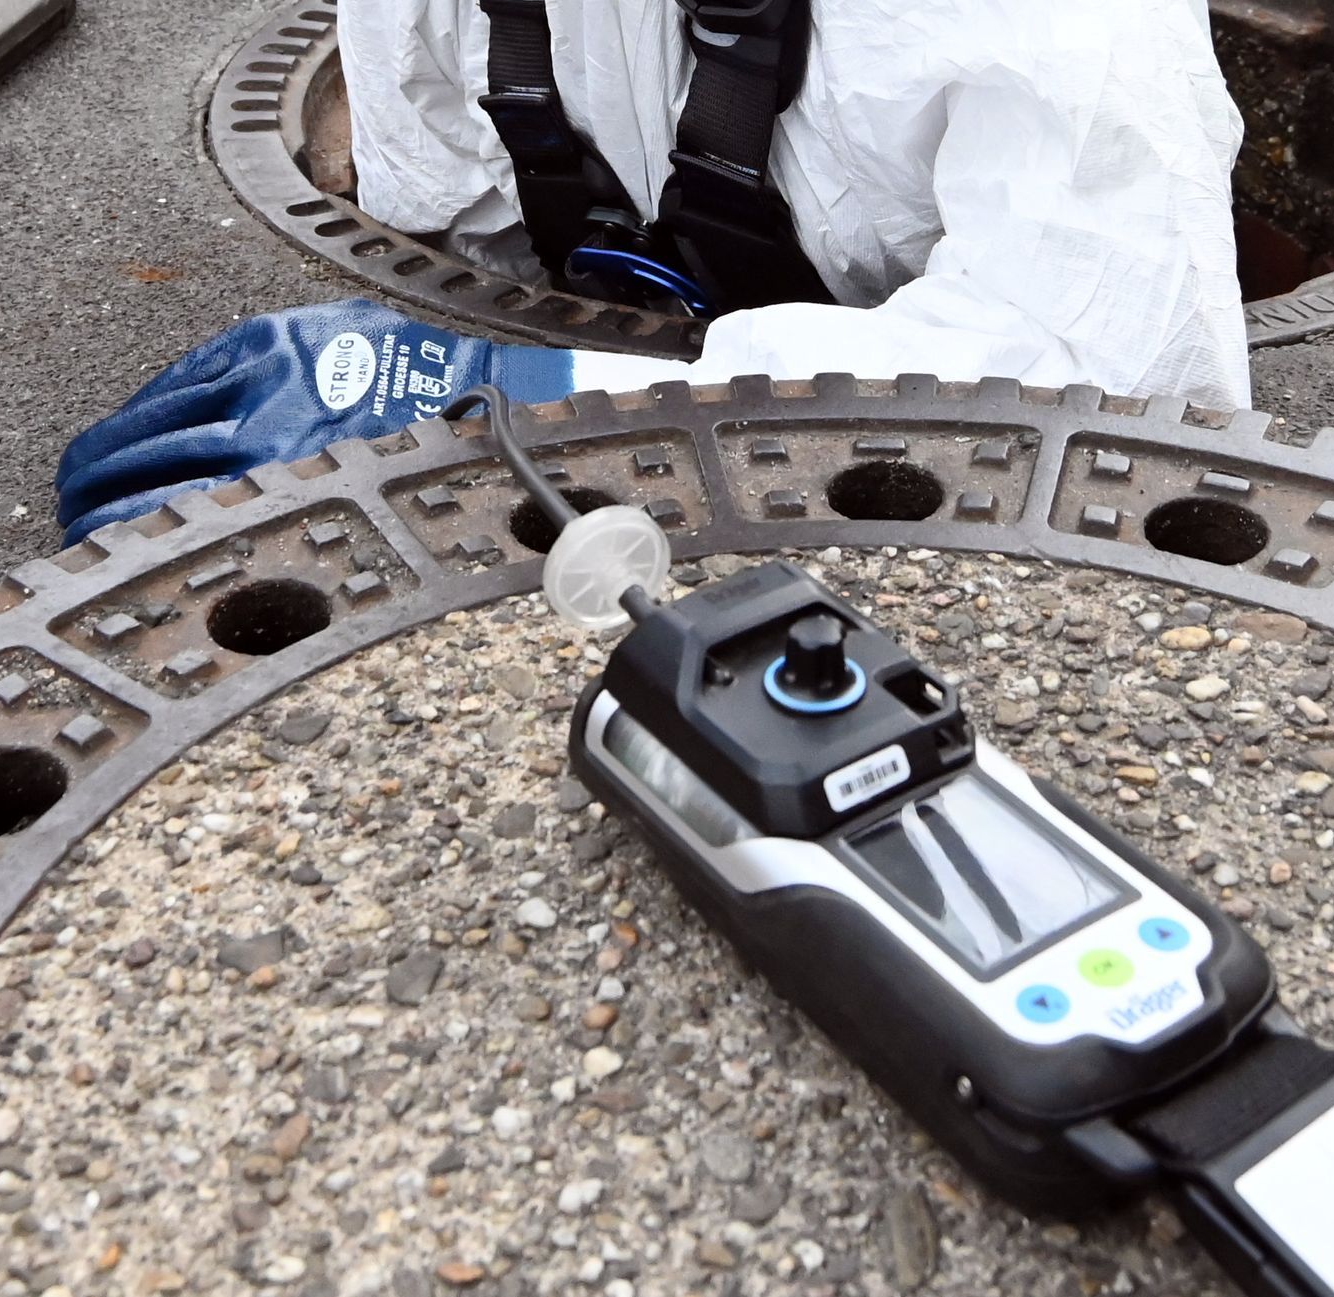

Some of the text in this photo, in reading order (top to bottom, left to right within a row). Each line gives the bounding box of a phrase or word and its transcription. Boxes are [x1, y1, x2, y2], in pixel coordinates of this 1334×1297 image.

[328, 339, 355, 403] STRONG
[356, 357, 370, 383] HAND
[392, 344, 411, 399] GROESSE 10
